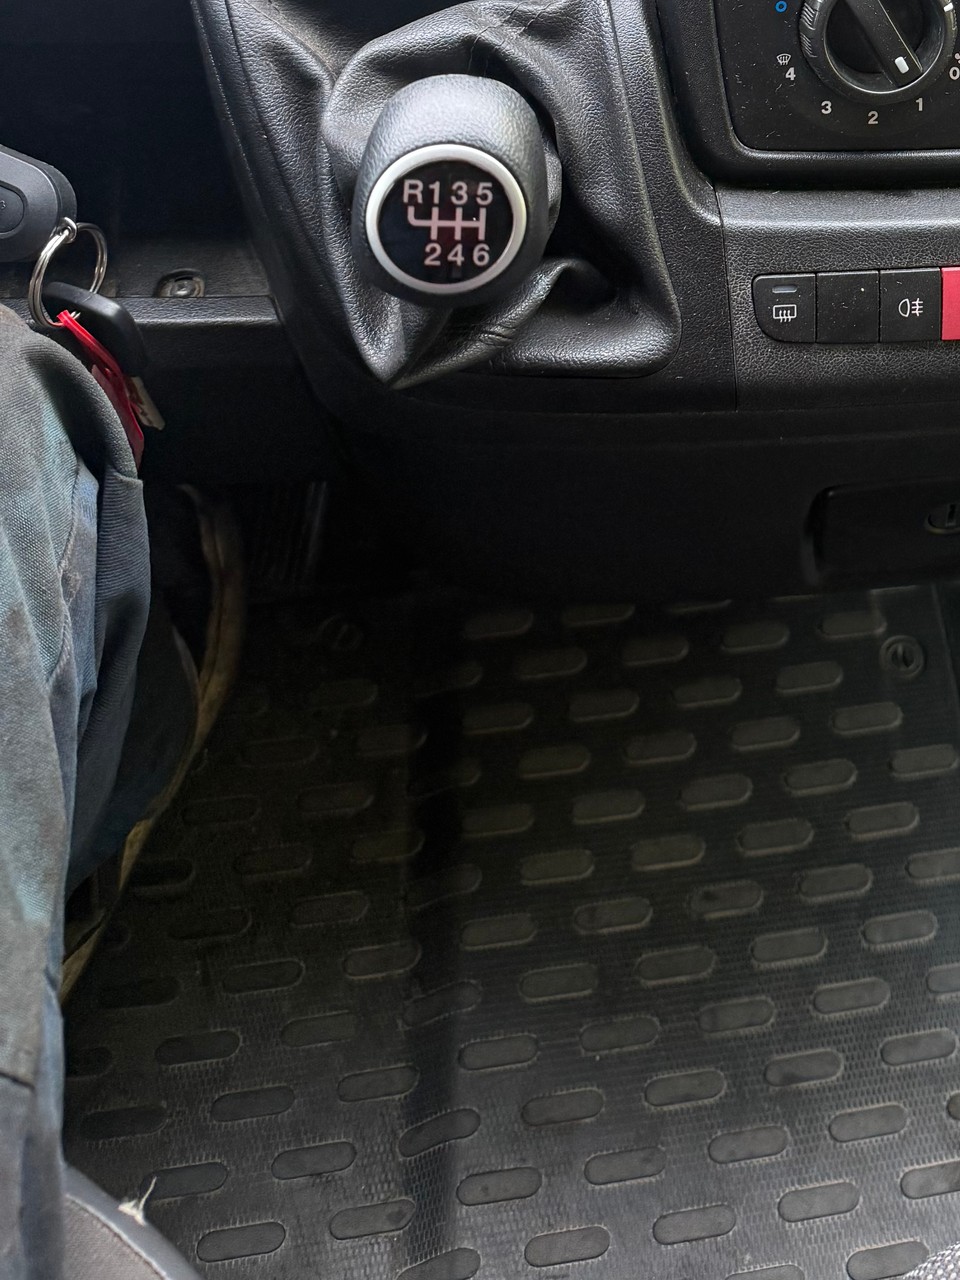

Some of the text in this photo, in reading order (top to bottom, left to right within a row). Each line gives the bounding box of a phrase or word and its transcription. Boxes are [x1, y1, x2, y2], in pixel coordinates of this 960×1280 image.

[785, 67, 796, 81] 4
[949, 68, 960, 81] 0
[821, 100, 832, 115] 3
[915, 97, 923, 112] 1
[867, 111, 879, 125] 2
